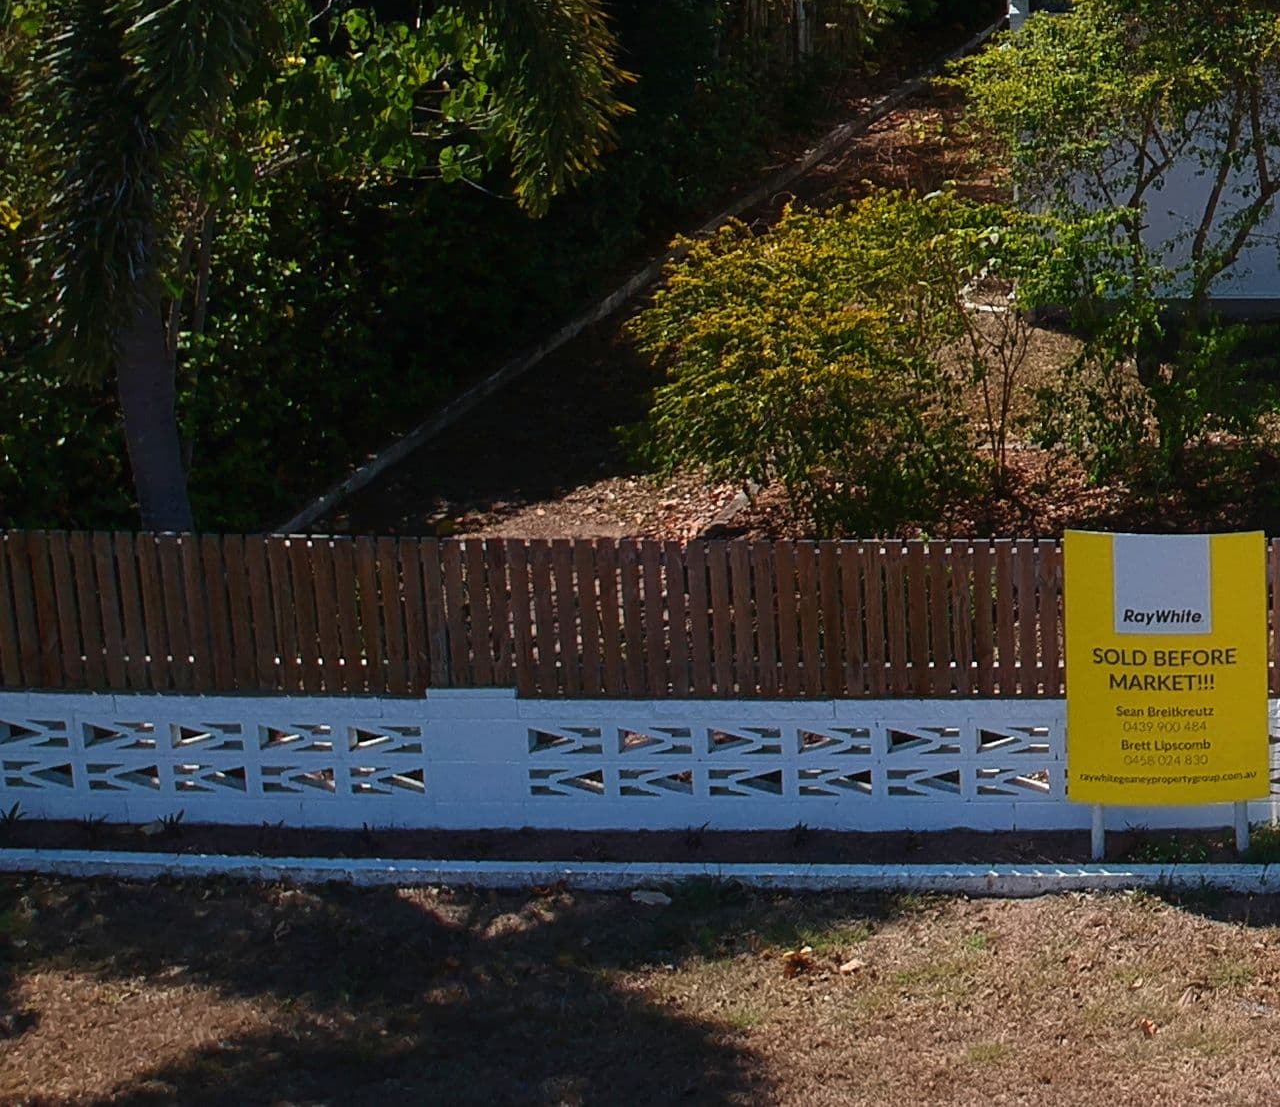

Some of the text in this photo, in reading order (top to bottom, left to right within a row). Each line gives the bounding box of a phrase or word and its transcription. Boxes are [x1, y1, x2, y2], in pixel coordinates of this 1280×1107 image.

[1092, 647, 1237, 667] SOLD BEFORE
[1109, 673, 1215, 691] MARKET!!!
[1116, 705, 1214, 718] Sean Breitkreutz
[1121, 739, 1211, 753] Brett Lipscomb
